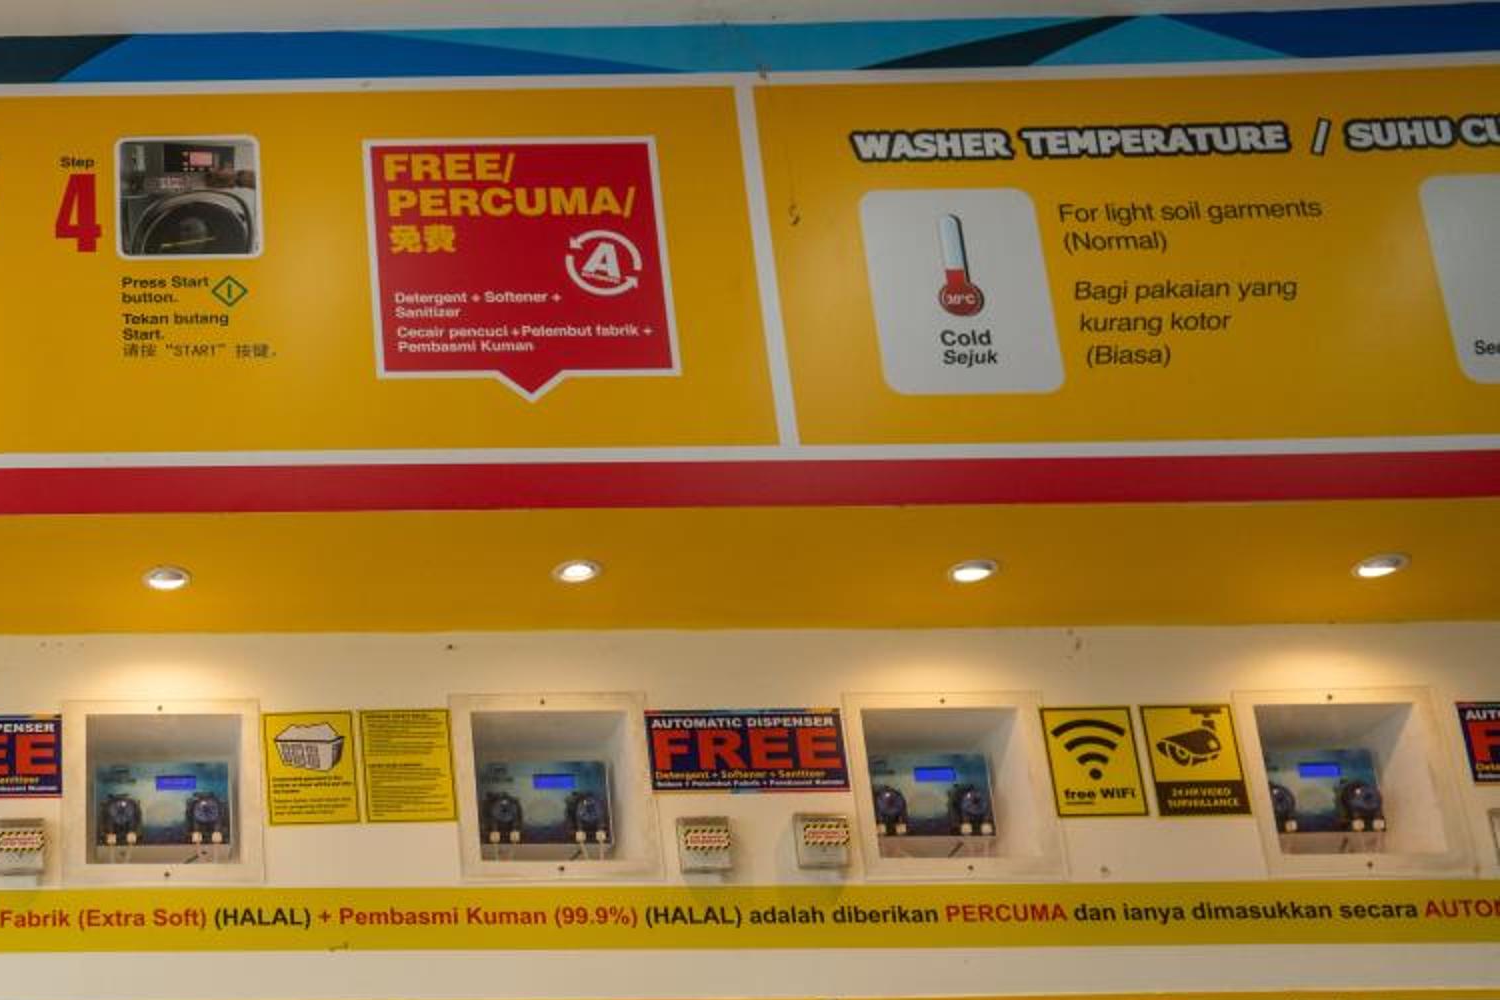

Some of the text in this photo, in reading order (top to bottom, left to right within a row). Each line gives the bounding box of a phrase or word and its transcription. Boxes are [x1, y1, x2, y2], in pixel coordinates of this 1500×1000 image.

[851, 130, 1013, 161] WASHER
[1020, 122, 1289, 159] TEMPERATURE
[1346, 120, 1453, 150] SUHU
[60, 156, 94, 169] Step
[384, 153, 515, 183] FREE/
[387, 186, 634, 217] PERCUMA/
[56, 173, 101, 252] 4
[1059, 199, 1323, 226] For light soil garments
[1064, 232, 1167, 252] (Normal)
[122, 276, 209, 288] Press Start
[122, 293, 179, 304] button.
[1075, 279, 1298, 304] Bagi pakaian yang
[123, 313, 229, 326] Tekan butang
[396, 307, 460, 318] Sanitizer
[1080, 312, 1231, 336] kurang kotor
[123, 329, 164, 340] Start.
[941, 330, 991, 346] Cold
[398, 341, 533, 352] Pembasmi Kuman
[943, 350, 997, 367] Sejuk
[1086, 345, 1171, 368] (Biasa)
[1065, 788, 1136, 800] free WiFi
[0, 910, 70, 929] Fabrik
[78, 909, 146, 931] (Extra
[154, 908, 207, 930] Soft)
[214, 907, 311, 930] (HALAL)
[319, 910, 331, 924] +
[339, 907, 458, 926] Pembasmi
[467, 907, 547, 926] Kuman
[555, 906, 638, 928] (99.9%)
[645, 905, 741, 928] (HALAL)
[749, 905, 825, 925] adalah
[832, 904, 938, 924] diberikan
[946, 904, 1067, 923] PERCUMA
[1074, 903, 1116, 922] dan
[1124, 902, 1184, 925] ianya
[1193, 901, 1332, 920] dimasukkan
[1339, 902, 1417, 919] secara
